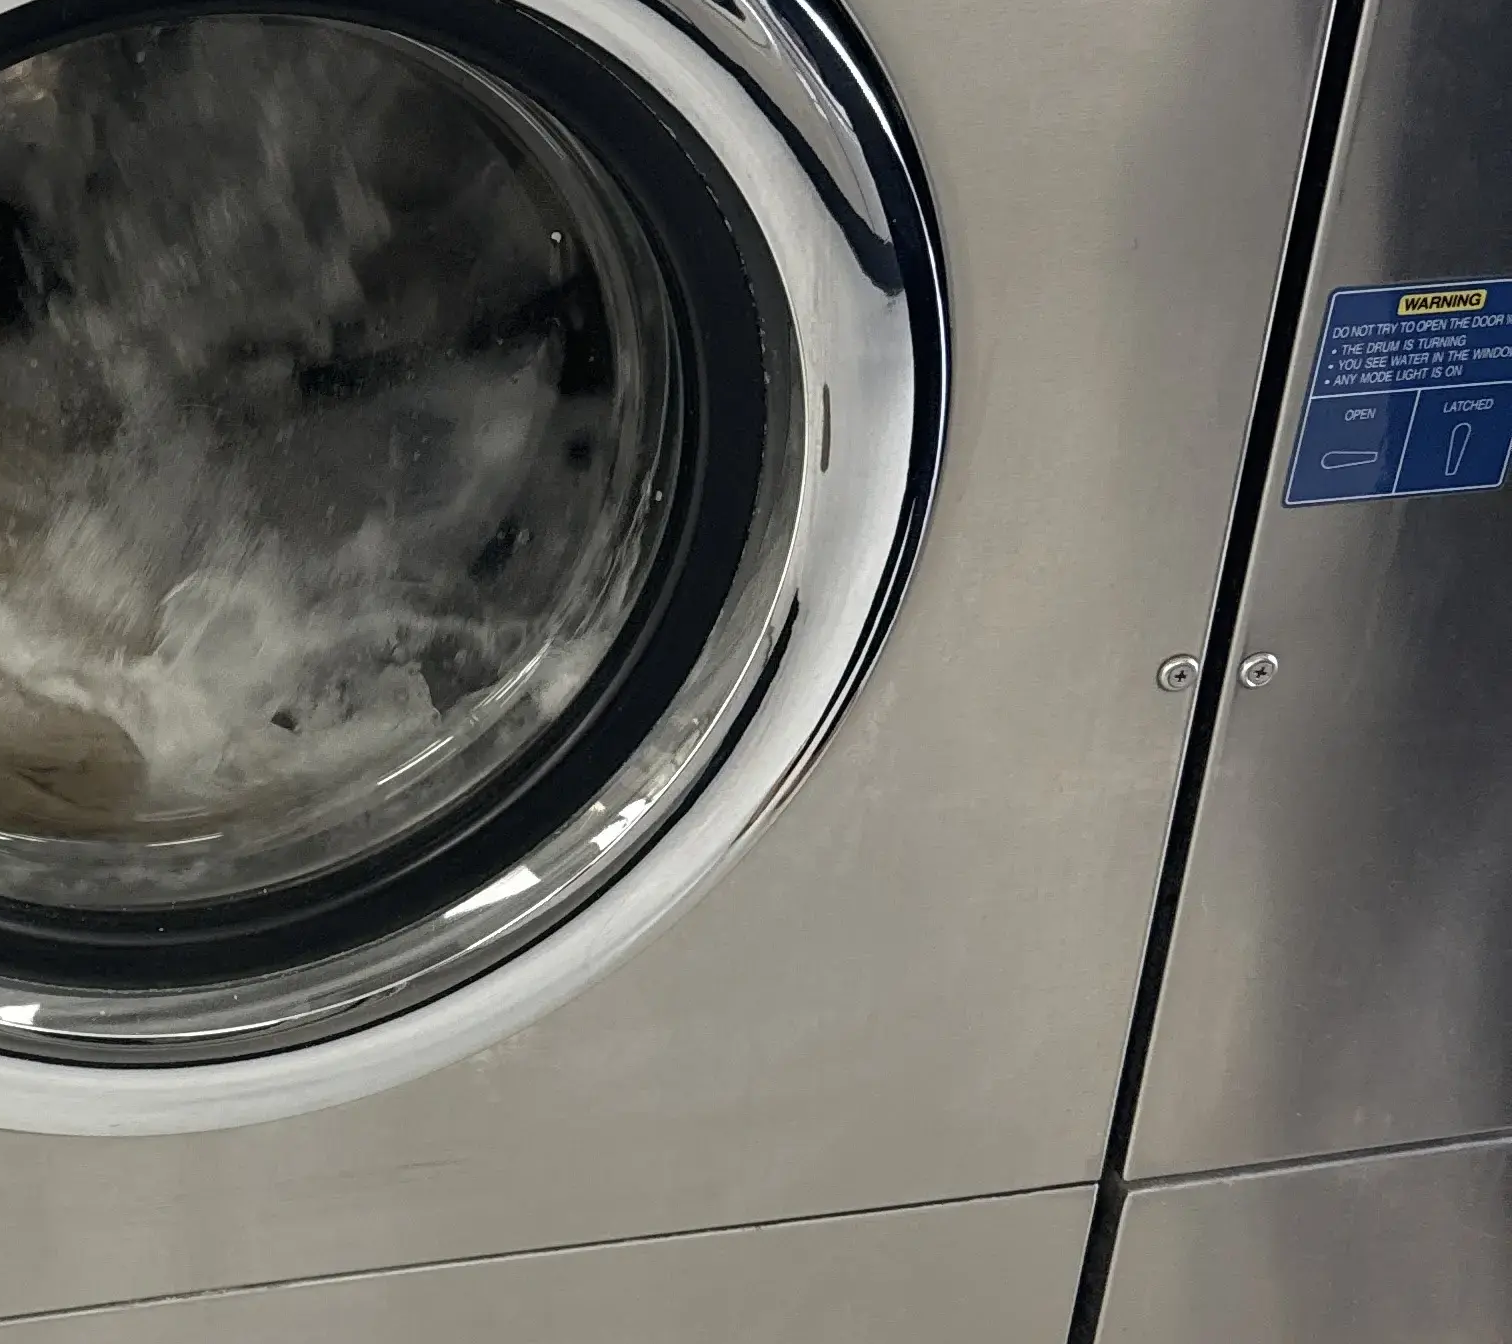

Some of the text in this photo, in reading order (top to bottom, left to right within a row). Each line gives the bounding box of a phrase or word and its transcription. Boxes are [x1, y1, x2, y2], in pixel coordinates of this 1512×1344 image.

[1405, 292, 1482, 311] WARNING
[1333, 326, 1349, 339] DO
[1351, 324, 1375, 337] NOT
[1377, 322, 1399, 335] TRY
[1400, 320, 1415, 333] TO
[1416, 318, 1447, 332] OPEN
[1450, 316, 1471, 329] THE
[1472, 314, 1504, 328] DOOR
[1342, 335, 1467, 356] THE DRUM IS TURNING
[1339, 346, 1512, 371] YOU SEE WATER IN THE WINDO
[1333, 364, 1464, 386] ANY MODE LIGHT IS ON
[1344, 408, 1376, 422] OPEN
[1443, 398, 1494, 413] LATCHED
